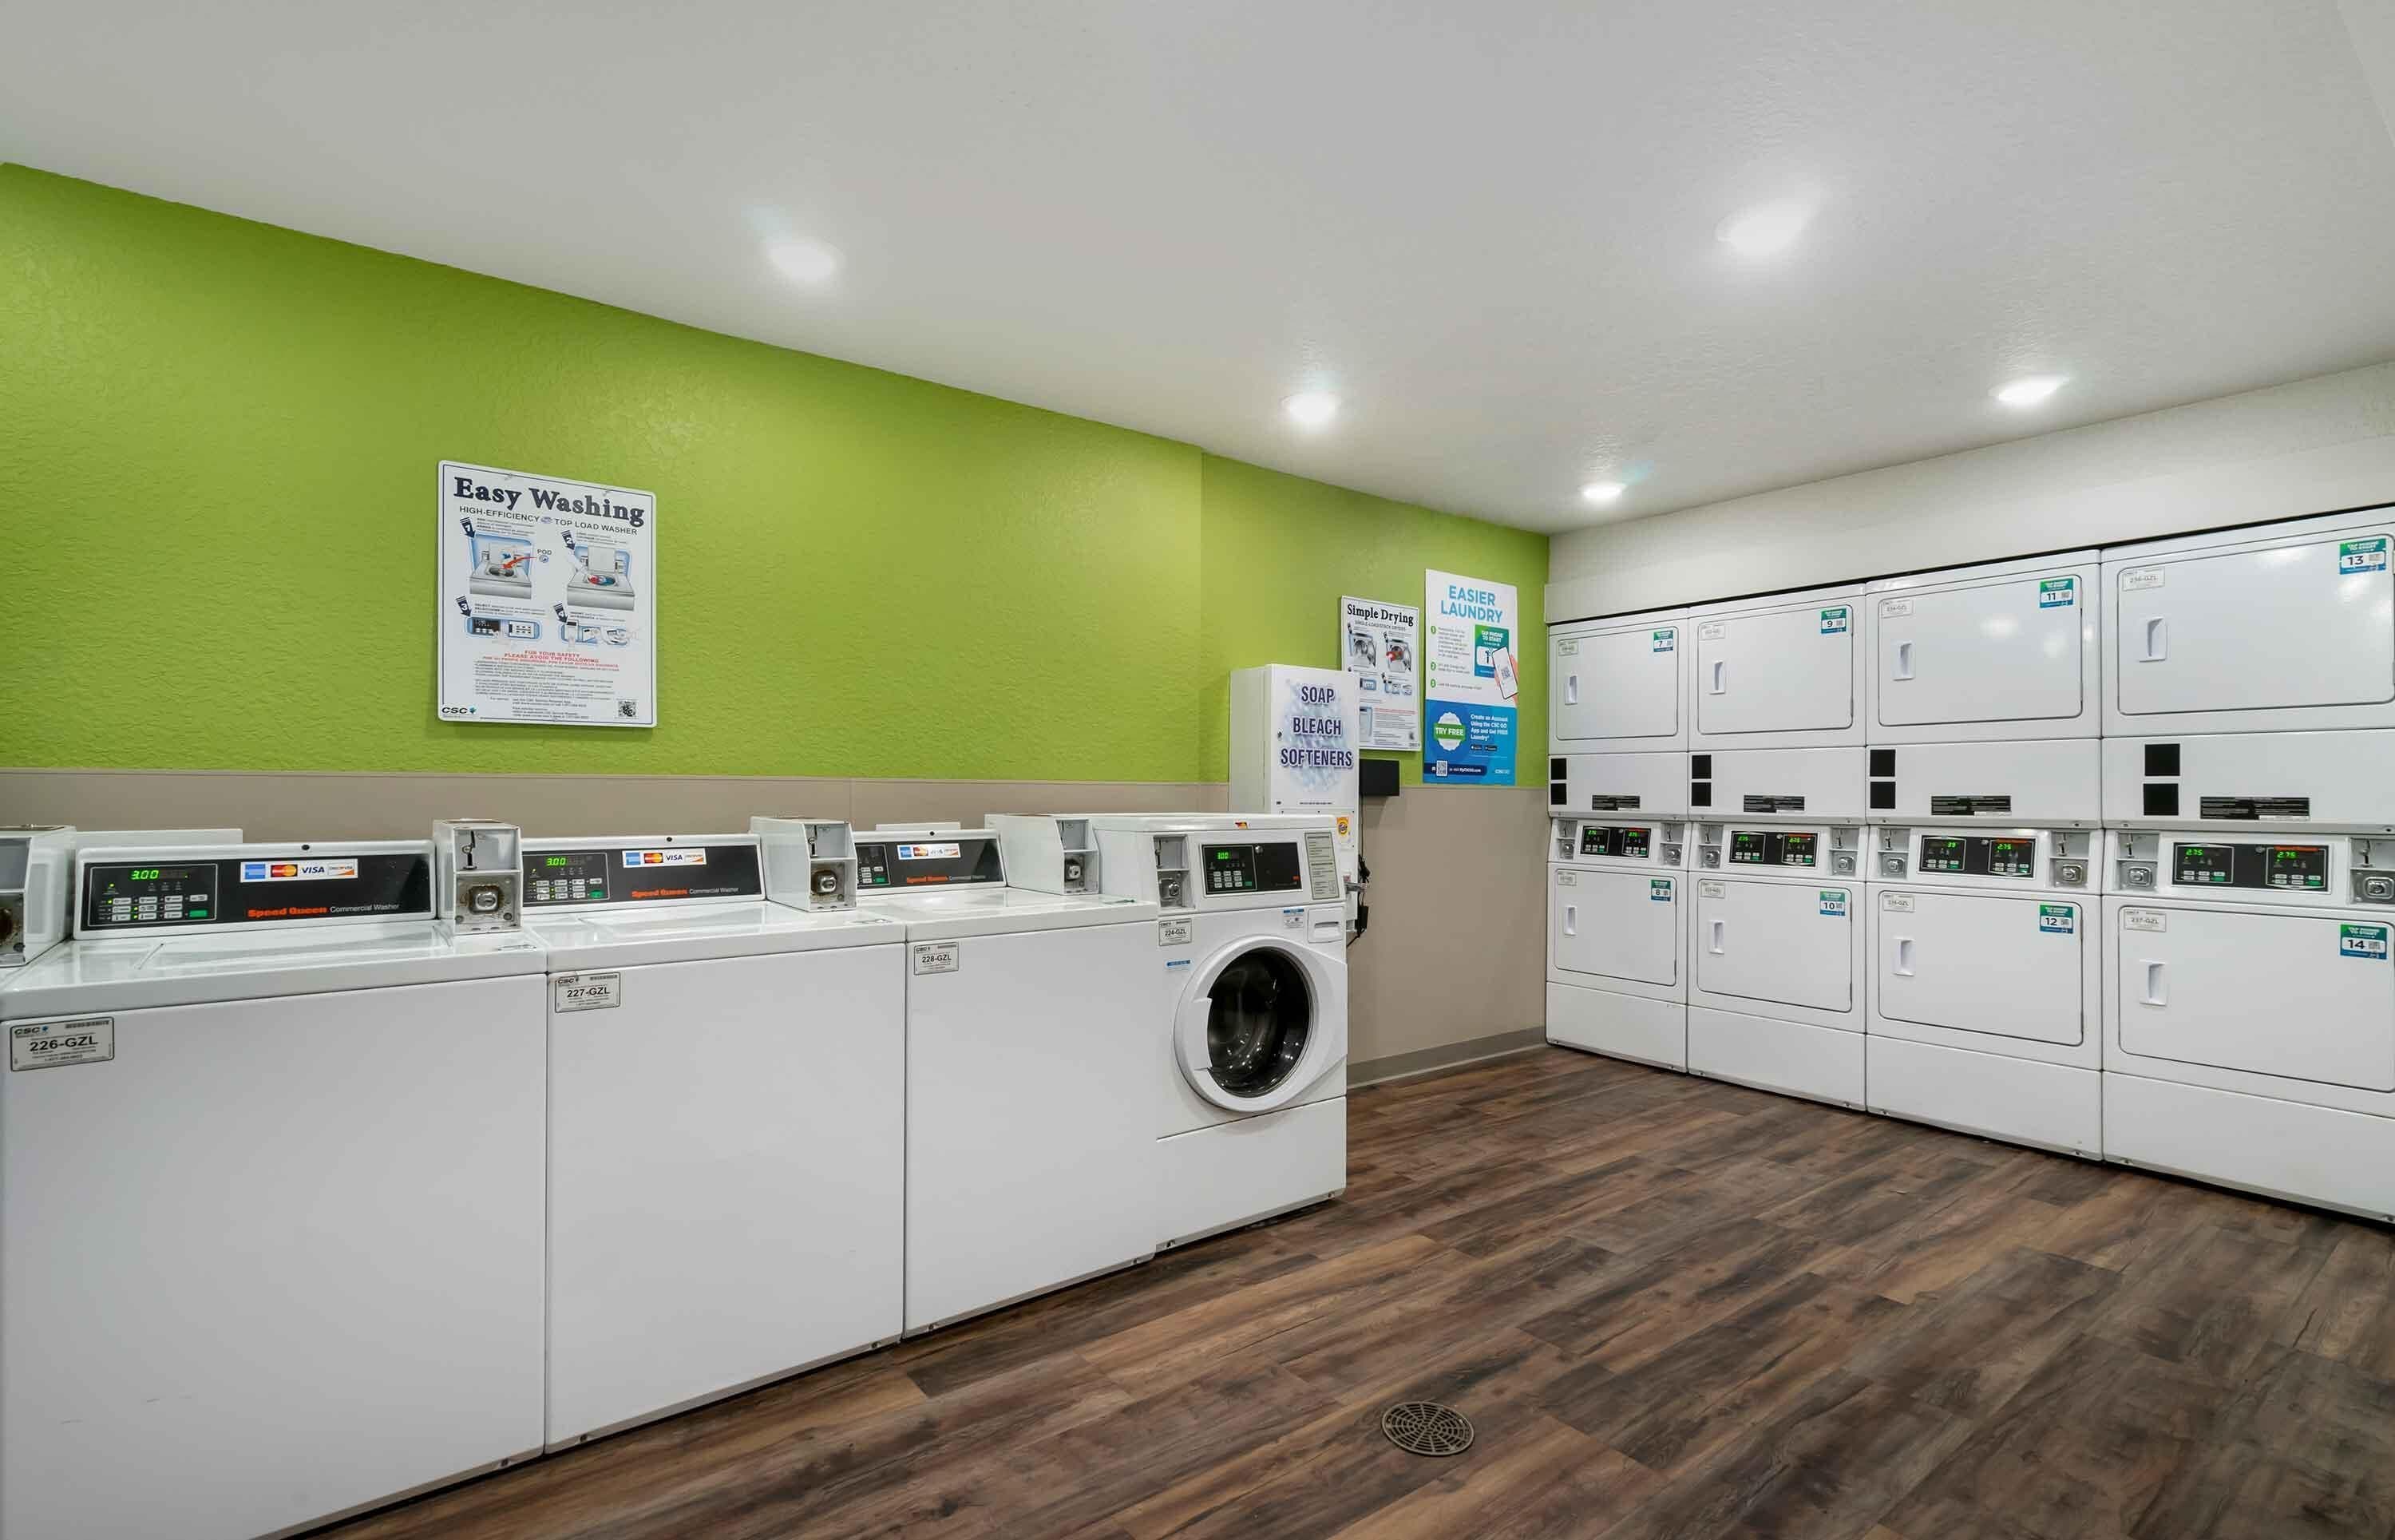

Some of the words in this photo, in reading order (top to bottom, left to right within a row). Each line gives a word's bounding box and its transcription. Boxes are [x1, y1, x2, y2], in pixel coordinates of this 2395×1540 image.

[453, 477, 522, 511] Easy
[528, 487, 644, 528] Washing
[459, 505, 540, 522] HIGH-EFFICIENCY
[575, 521, 599, 530] LOAD
[601, 525, 638, 536] WASHER
[2347, 555, 2364, 566] 13
[1449, 584, 1495, 607] EASIER
[2046, 592, 2056, 601] 11
[1347, 604, 1379, 621] Simple
[1380, 608, 1414, 627] Drying
[1440, 600, 1502, 624] LAUNDRY
[1301, 686, 1335, 703] SOAP
[1293, 717, 1342, 736] BLEACH
[1448, 727, 1465, 736] FREE
[1281, 748, 1353, 767] SOFTENERS
[247, 907, 287, 918] Speed
[289, 906, 328, 916] Queen
[330, 904, 373, 913] Commercial
[373, 902, 400, 911] Washer
[2045, 917, 2057, 926] 12
[2347, 939, 2365, 949] 14
[922, 954, 952, 963] 228-GZL
[567, 987, 611, 998] 227-GZL
[30, 1035, 99, 1052] 226-GZL
